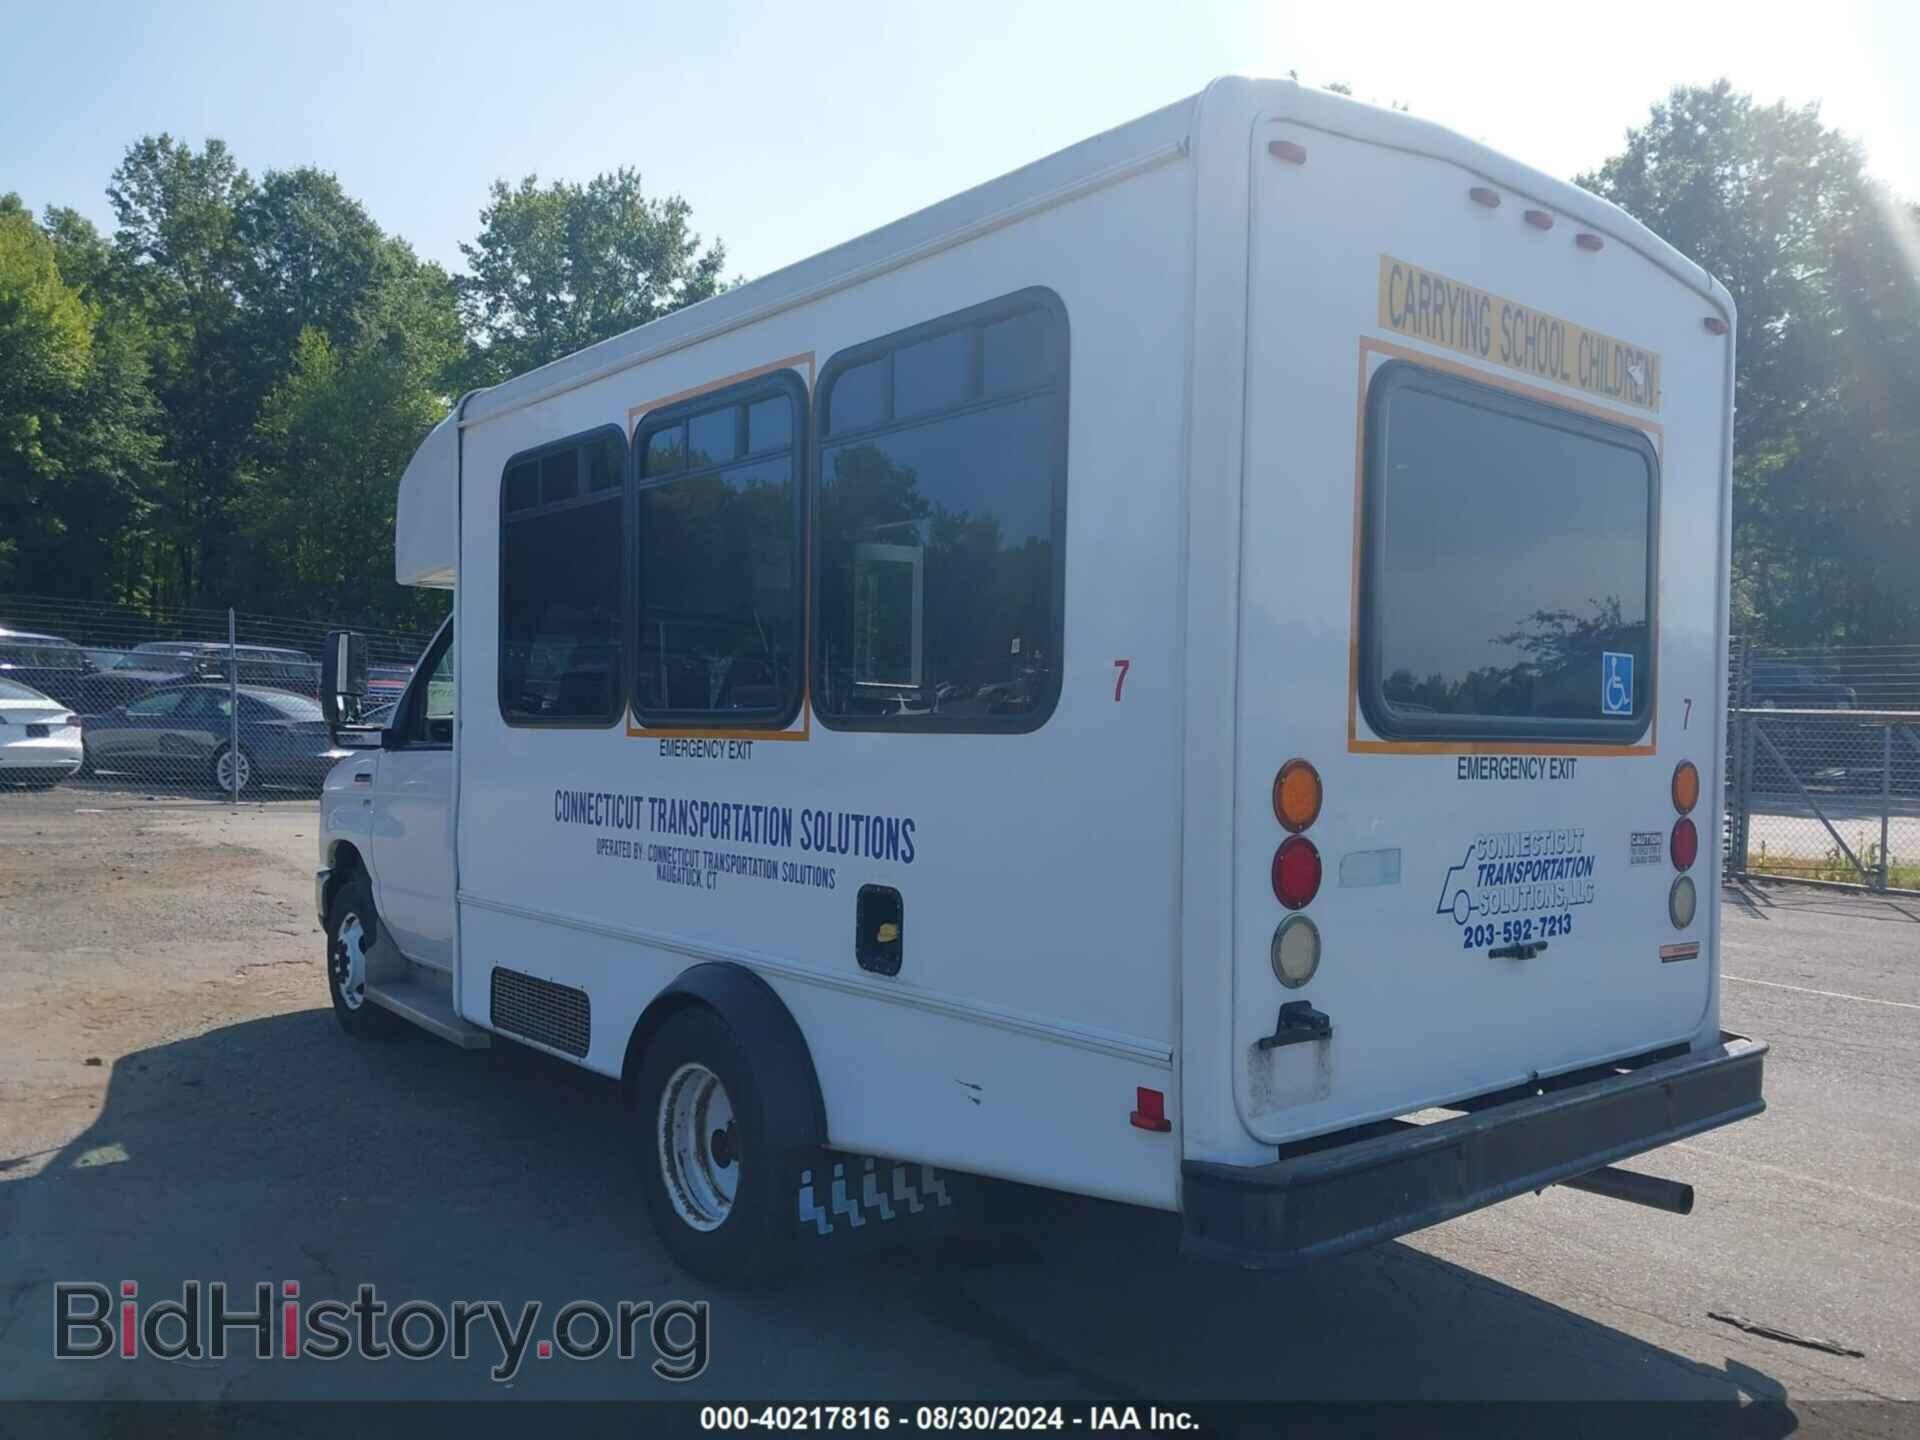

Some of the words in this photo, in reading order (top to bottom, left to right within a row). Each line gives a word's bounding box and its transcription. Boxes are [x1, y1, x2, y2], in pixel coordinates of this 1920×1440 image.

[1389, 263, 1491, 356] CARRYING
[1500, 303, 1569, 381] SCHOOL
[1578, 332, 1656, 409] CHILDREN
[1114, 659, 1129, 702] 7
[1683, 698, 1692, 730] 7
[659, 738, 725, 758] EMERGENCY
[729, 740, 753, 760] EXIT
[1457, 756, 1545, 780] EMERGENCY
[1549, 758, 1577, 779] EXIT
[554, 789, 644, 831] CONNECTICUT
[648, 797, 793, 848] TRANSPORTATION
[800, 808, 916, 864] SOLUTIONS
[1475, 828, 1585, 861] CONNECTICUT
[596, 838, 632, 860] OPERATED
[648, 844, 700, 869] CONNECTICUT
[703, 851, 779, 881] TRANSPORTATION
[782, 861, 836, 890] SOLUTIONS
[1476, 855, 1596, 887] TRANSPORTATION
[707, 872, 718, 891] CT
[1463, 914, 1573, 949] 203-592-7213
